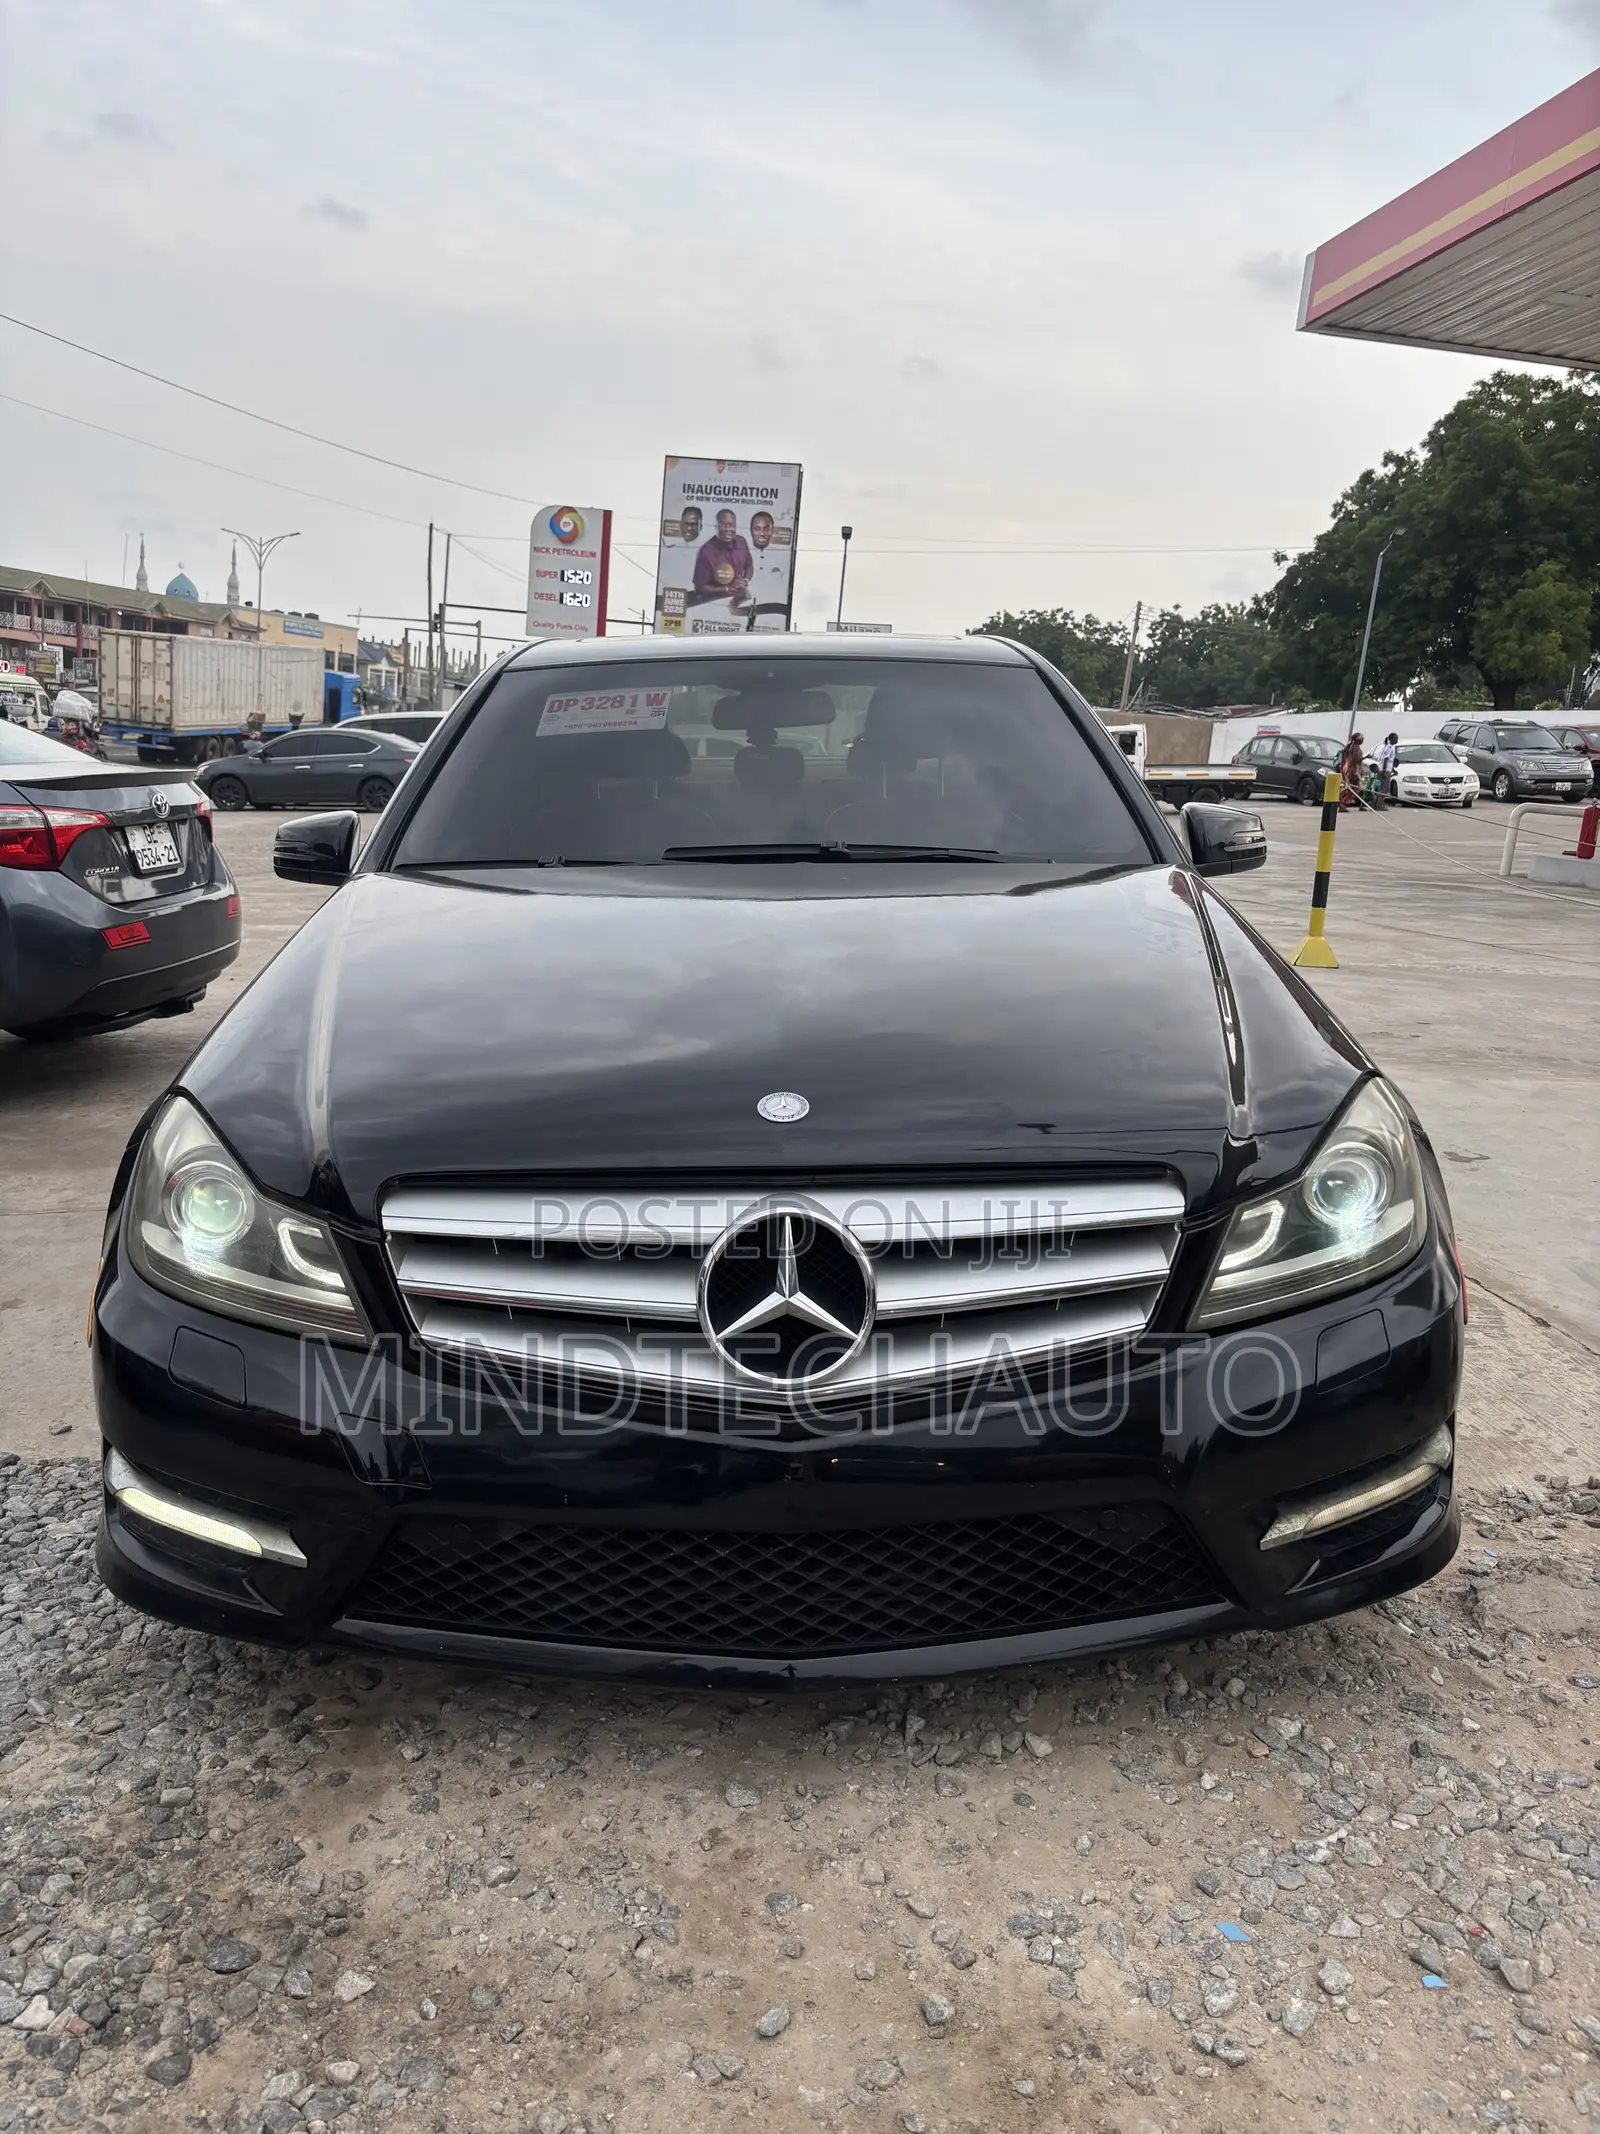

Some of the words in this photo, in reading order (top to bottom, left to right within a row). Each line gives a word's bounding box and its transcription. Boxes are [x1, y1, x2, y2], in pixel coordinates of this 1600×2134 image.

[682, 483, 778, 499] INAUGURATION
[533, 546, 551, 554] NICK
[552, 548, 597, 558] PETROLEUM
[535, 570, 558, 579] SUPER
[534, 592, 558, 602] DIESEL
[663, 598, 685, 607] JUNE
[533, 620, 555, 631] Quality
[556, 622, 574, 632] Fuels
[574, 624, 589, 633] Only
[547, 698, 579, 713] DP
[581, 694, 639, 710] 3281
[646, 693, 667, 707] W
[143, 826, 158, 844] GE
[136, 844, 178, 867] 9534-21
